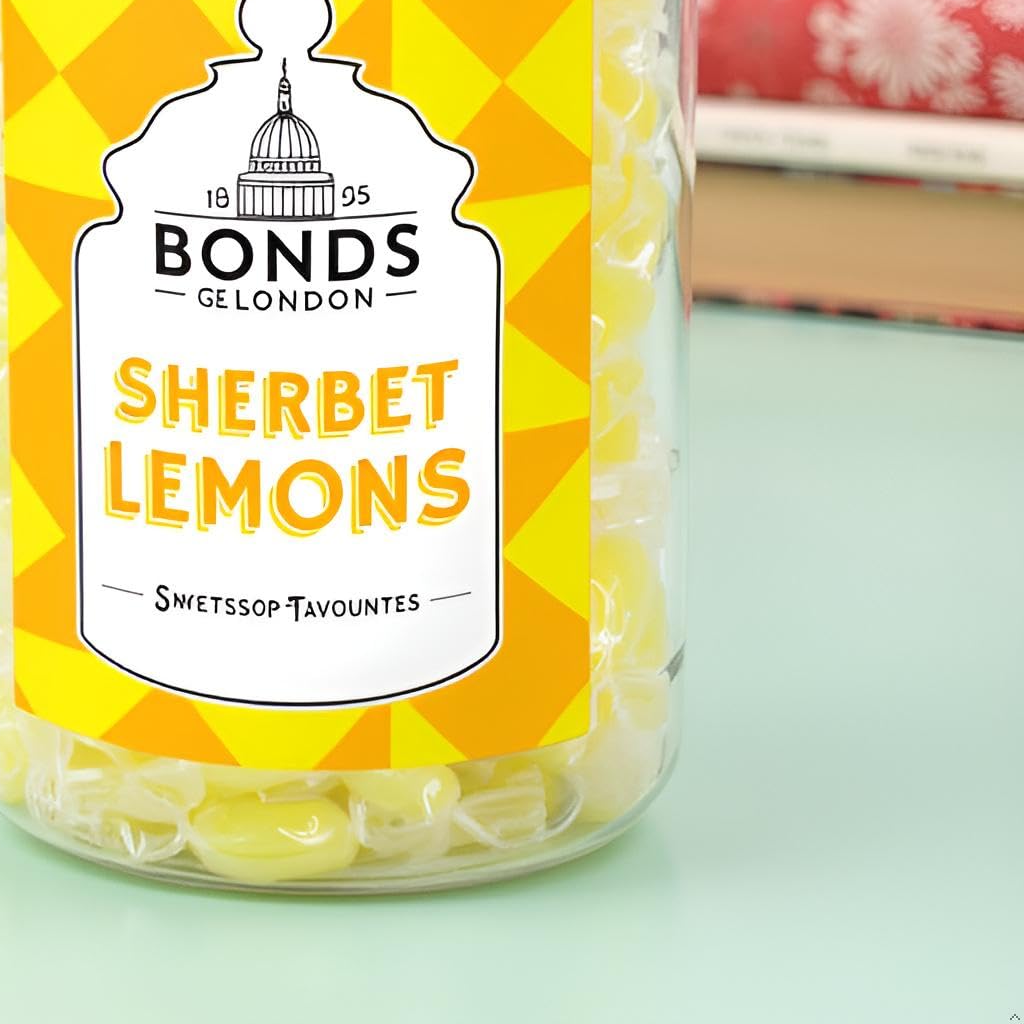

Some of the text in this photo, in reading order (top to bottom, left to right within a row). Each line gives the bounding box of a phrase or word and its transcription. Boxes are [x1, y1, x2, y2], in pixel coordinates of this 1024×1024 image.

[206, 184, 371, 209] 18 95
[155, 222, 420, 283] BONDS
[113, 357, 459, 439] SHERBET
[103, 440, 471, 538] LEMONS
